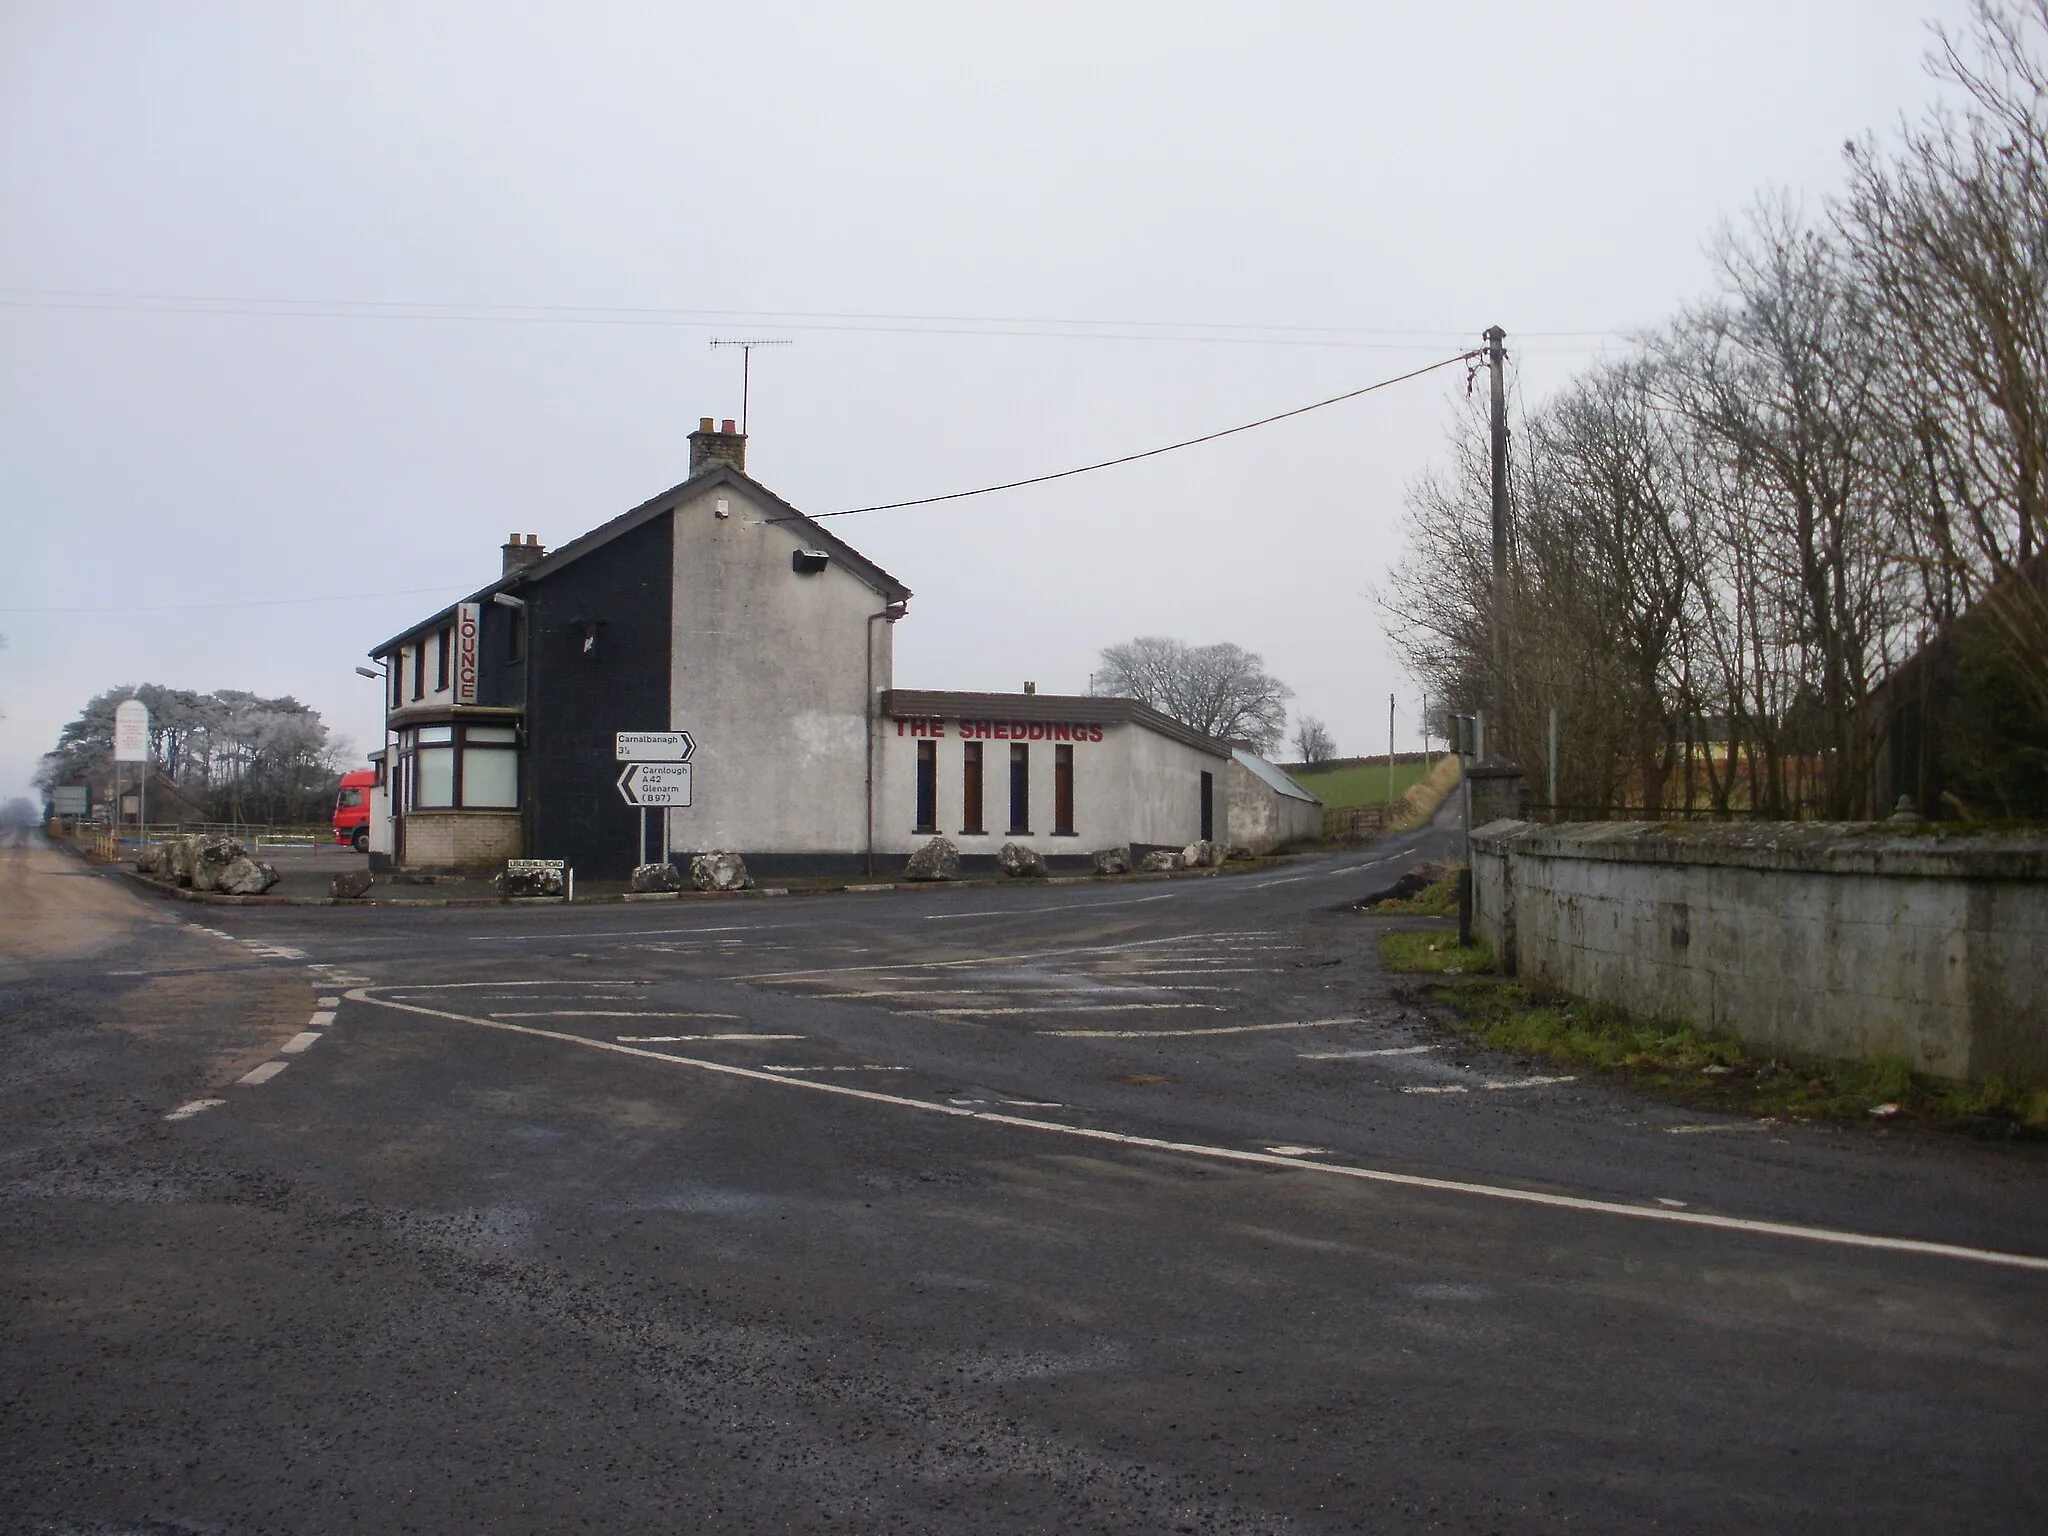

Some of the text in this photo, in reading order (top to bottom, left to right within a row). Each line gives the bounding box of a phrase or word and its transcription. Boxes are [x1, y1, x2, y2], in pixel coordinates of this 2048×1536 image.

[461, 608, 476, 698] LOUNGE
[893, 718, 1104, 743] THE SHEDDINGS
[618, 735, 678, 745] Carnalbanagh
[642, 766, 688, 776] Carnlough
[642, 784, 679, 793] Glenarm
